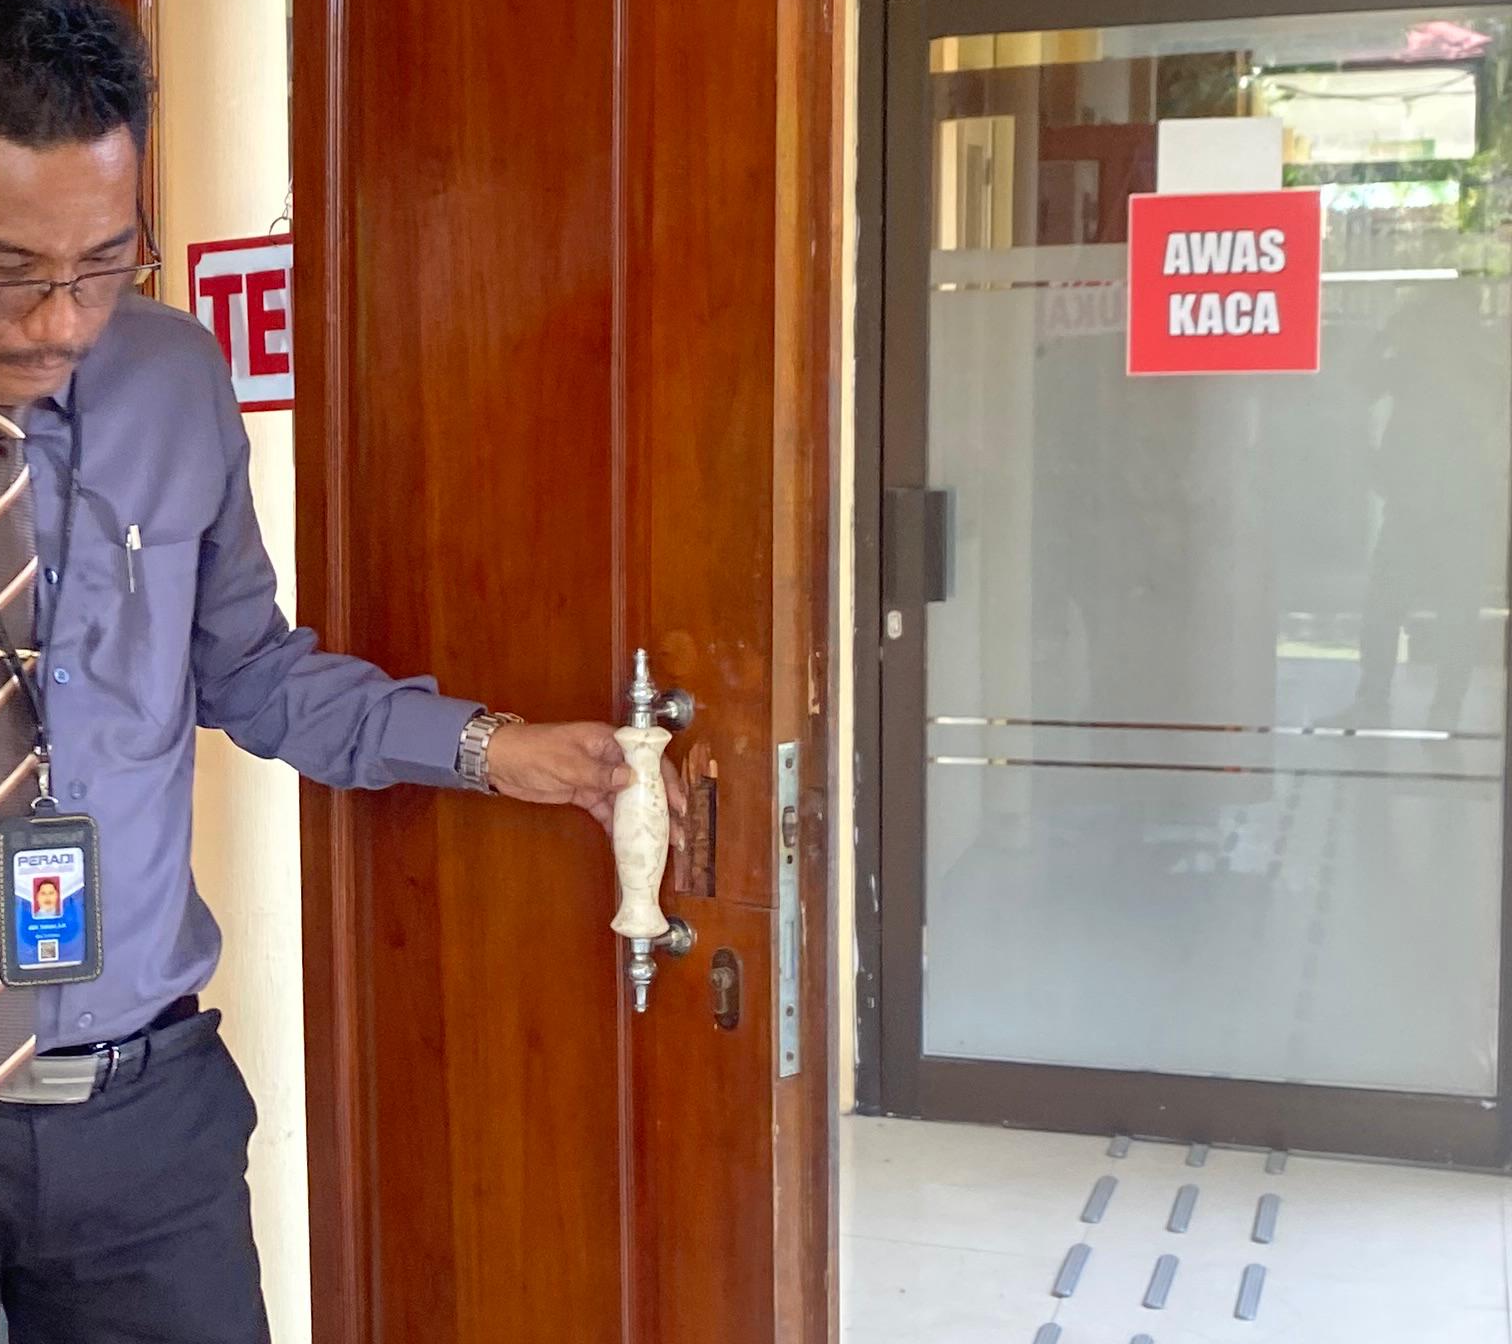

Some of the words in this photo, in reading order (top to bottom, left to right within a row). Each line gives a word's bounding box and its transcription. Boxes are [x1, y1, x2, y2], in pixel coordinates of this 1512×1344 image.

[1163, 228, 1286, 275] AWAS
[1169, 290, 1281, 337] KACA
[17, 853, 75, 868] PERADI
